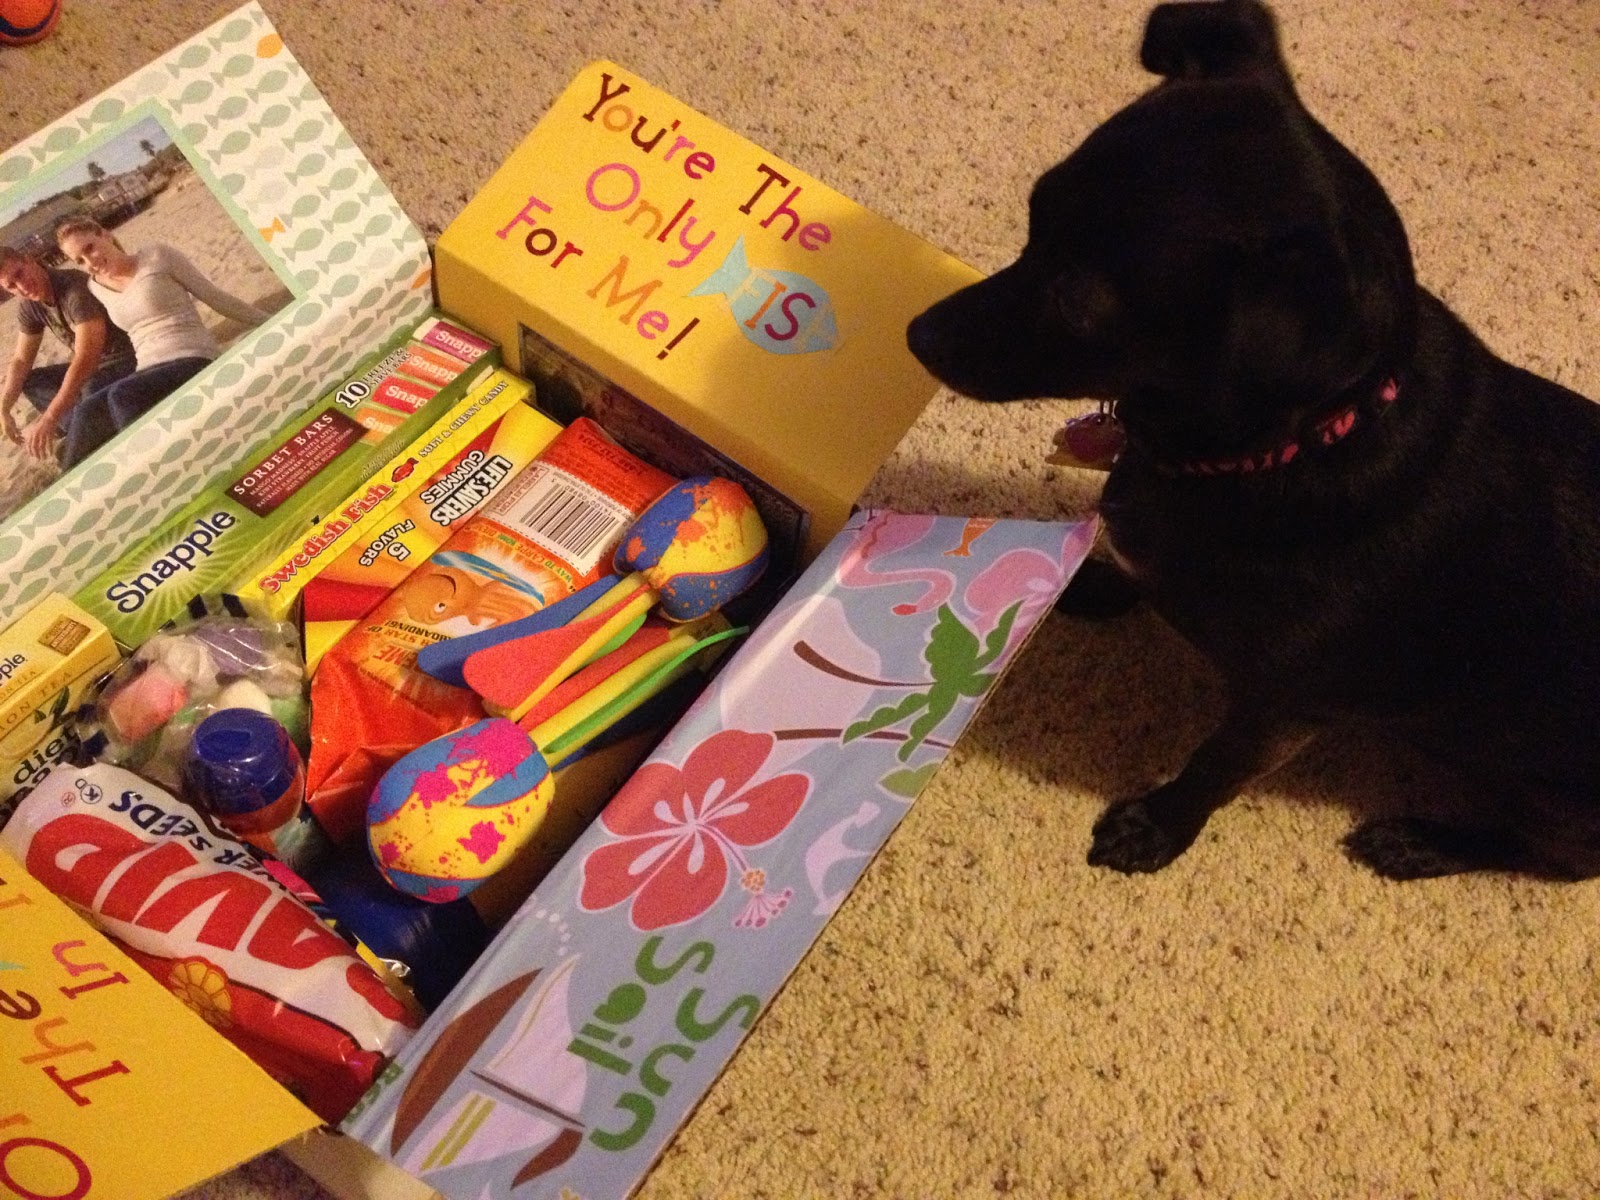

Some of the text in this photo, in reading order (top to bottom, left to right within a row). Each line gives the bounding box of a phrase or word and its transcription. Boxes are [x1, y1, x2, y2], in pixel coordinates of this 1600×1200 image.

[582, 73, 832, 251] You're The
[585, 163, 717, 269] Only
[495, 195, 700, 361] For Me!
[335, 381, 370, 408] 10
[362, 355, 396, 382] FREEZE
[369, 350, 412, 387] SERVE BARS
[418, 379, 510, 458] SOFT & CHEWY CANDY
[233, 413, 334, 496] SORBET BARS
[419, 450, 485, 505] GUMMIES
[249, 477, 271, 496] MANGO
[106, 510, 236, 614] Snapple
[259, 481, 394, 593] Swedish Fish
[358, 518, 416, 568] FLAVORS
[384, 541, 412, 562] 5
[513, 542, 545, 564] CARPE
[543, 558, 556, 570] TO
[383, 619, 451, 643] BOARDING!
[41, 671, 72, 697] TEA
[108, 790, 212, 852] SEEDS
[52, 939, 130, 1000] In
[588, 987, 761, 1152] Sun
